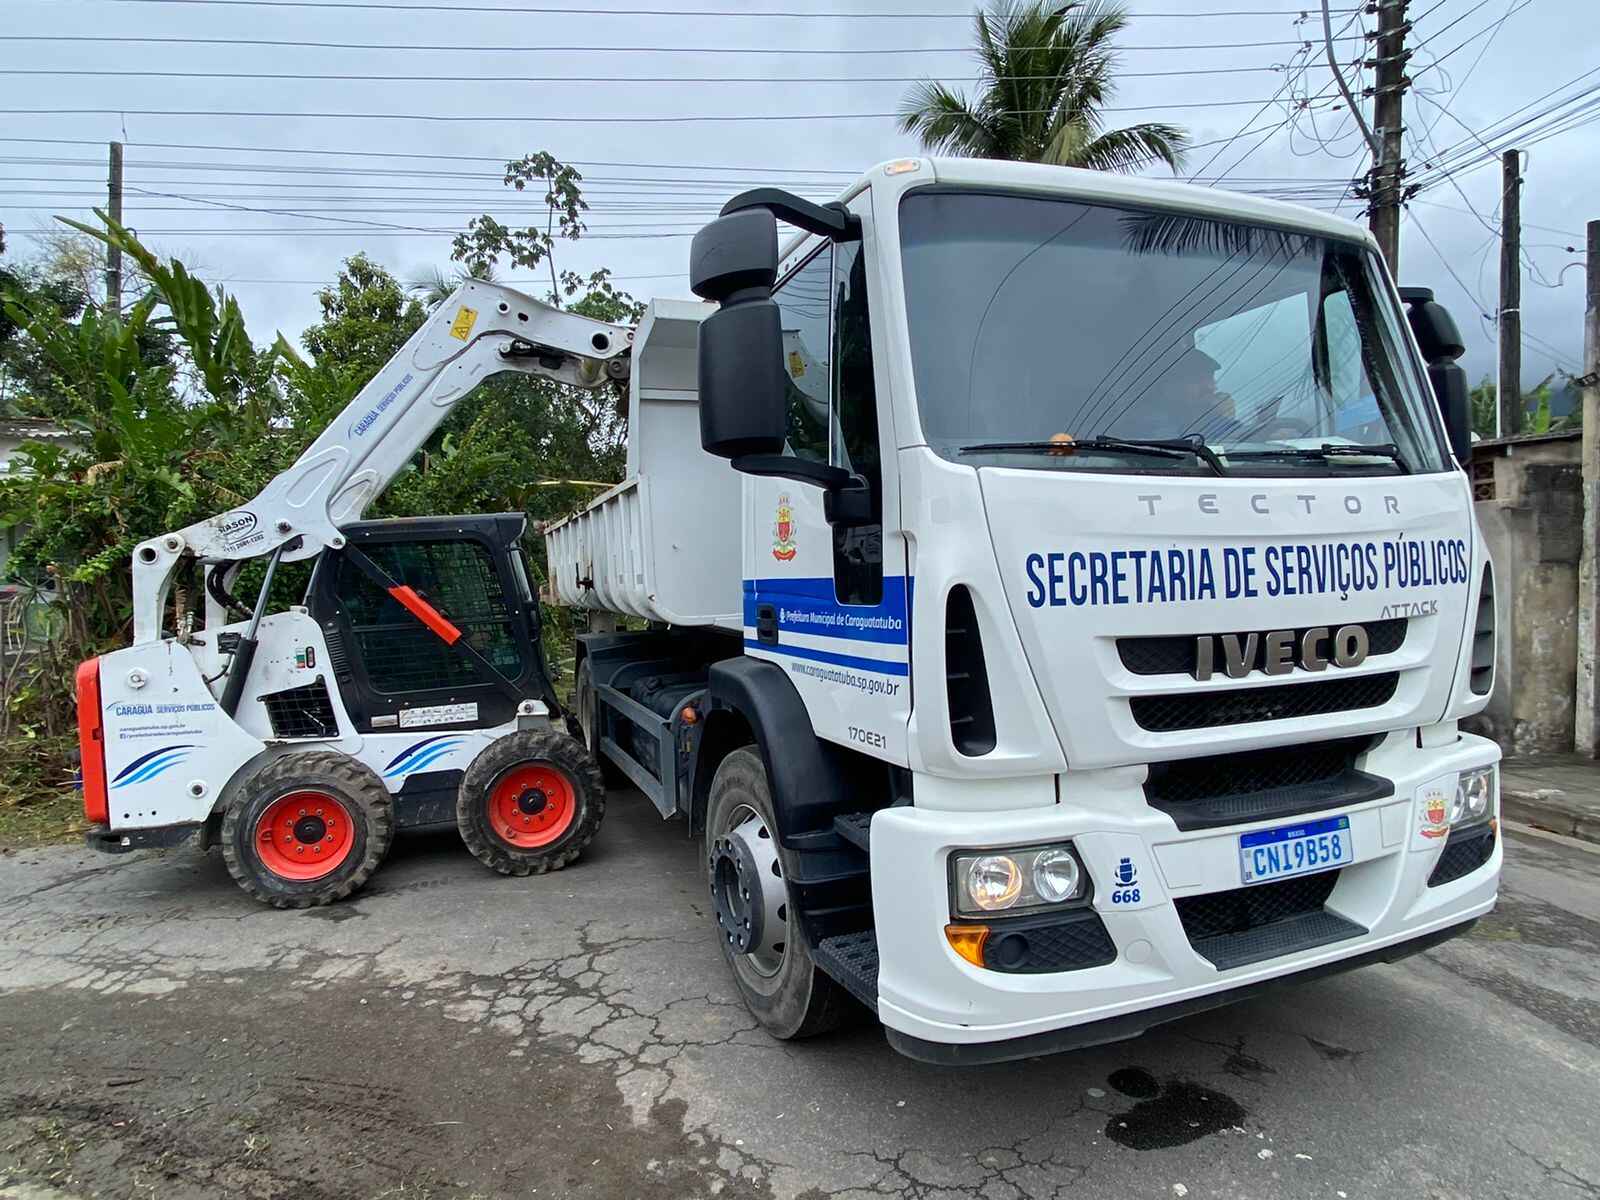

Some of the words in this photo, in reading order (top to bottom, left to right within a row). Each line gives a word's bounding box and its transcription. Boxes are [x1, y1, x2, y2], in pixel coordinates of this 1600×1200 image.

[1137, 494, 1402, 516] TECTOR
[1025, 547, 1217, 608] SECRETARIA
[1223, 547, 1259, 600] DE
[1264, 542, 1378, 601] SERVIÇOS
[1383, 531, 1468, 589] PÚBLICOS
[786, 610, 810, 624] Prefeitura
[810, 611, 836, 628] Municipal
[836, 612, 845, 626] de
[845, 613, 902, 630] Caraguatatuba
[1380, 599, 1439, 619] ATTACK
[1194, 624, 1370, 682] IVECO
[791, 661, 900, 696] www.caraguatatuba.sp.gov.br
[847, 726, 887, 749] 170E21
[1252, 833, 1342, 876] CNI9B58
[1111, 887, 1141, 904] 668
